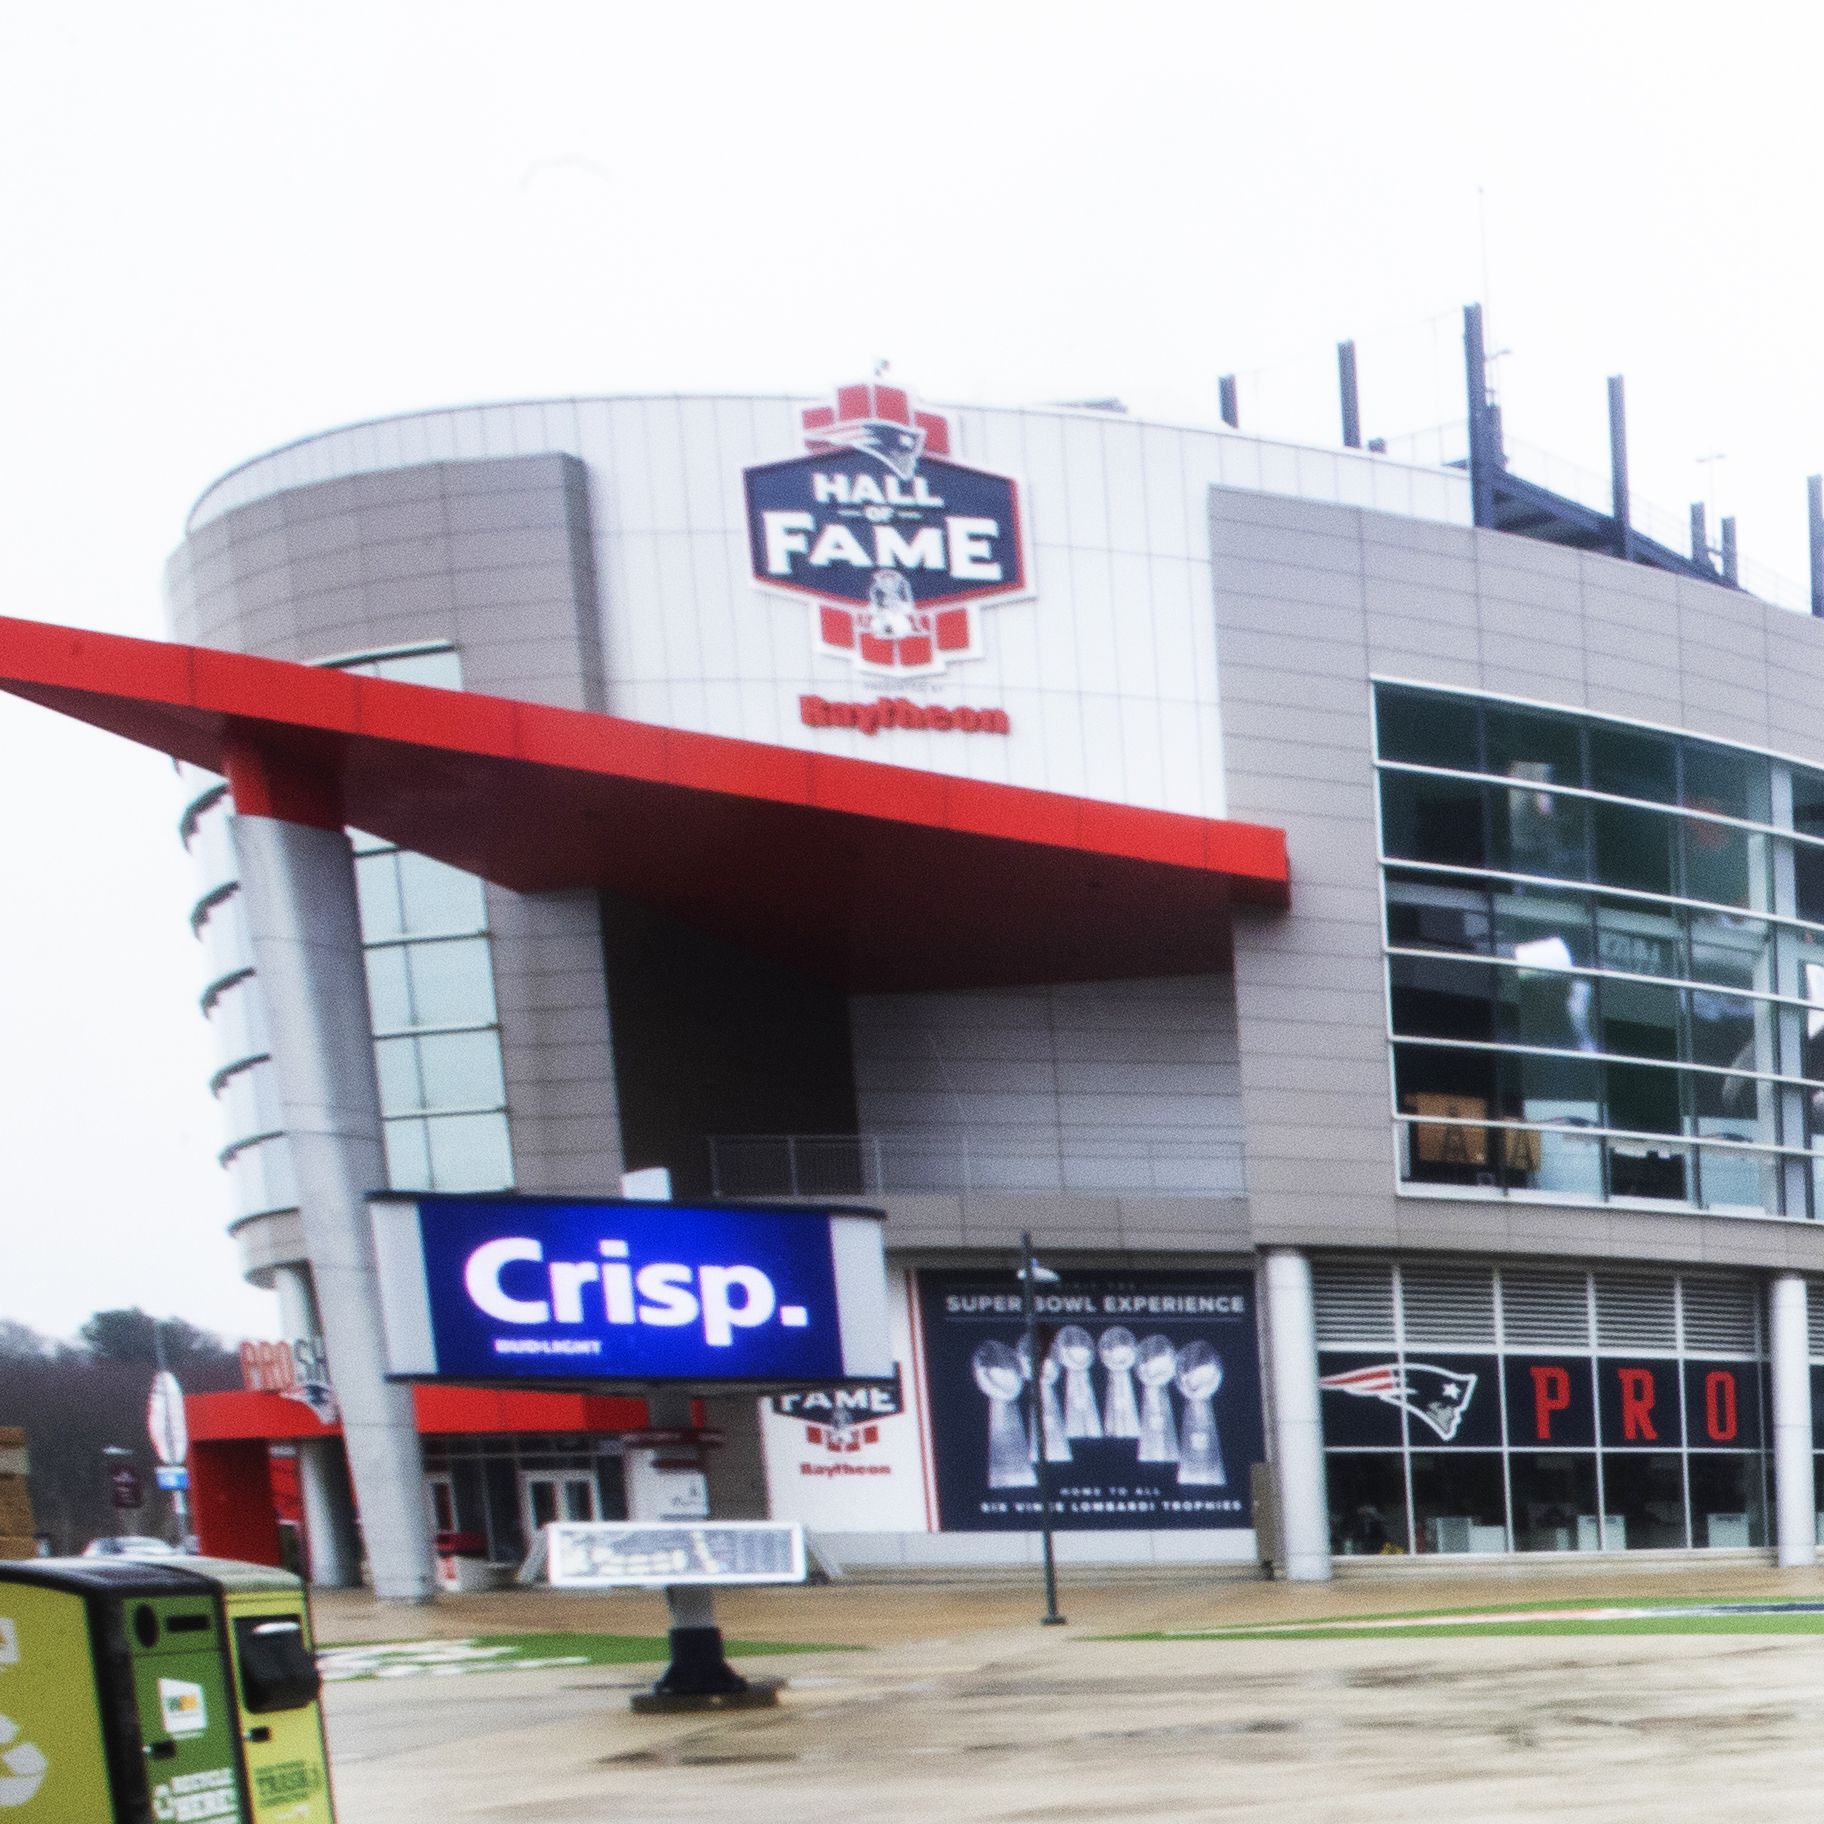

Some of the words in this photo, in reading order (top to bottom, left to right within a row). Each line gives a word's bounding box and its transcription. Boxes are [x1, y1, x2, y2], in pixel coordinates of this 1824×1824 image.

[812, 472, 944, 508] HALL
[761, 510, 1004, 582] FAME
[799, 694, 1010, 735] Raytheon
[463, 1235, 808, 1346] Crisp.
[944, 1294, 1023, 1313] SUPER
[1103, 1295, 1246, 1314] EXPERIENCE
[781, 1387, 897, 1413] FAME
[1529, 1364, 1739, 1442] PRO
